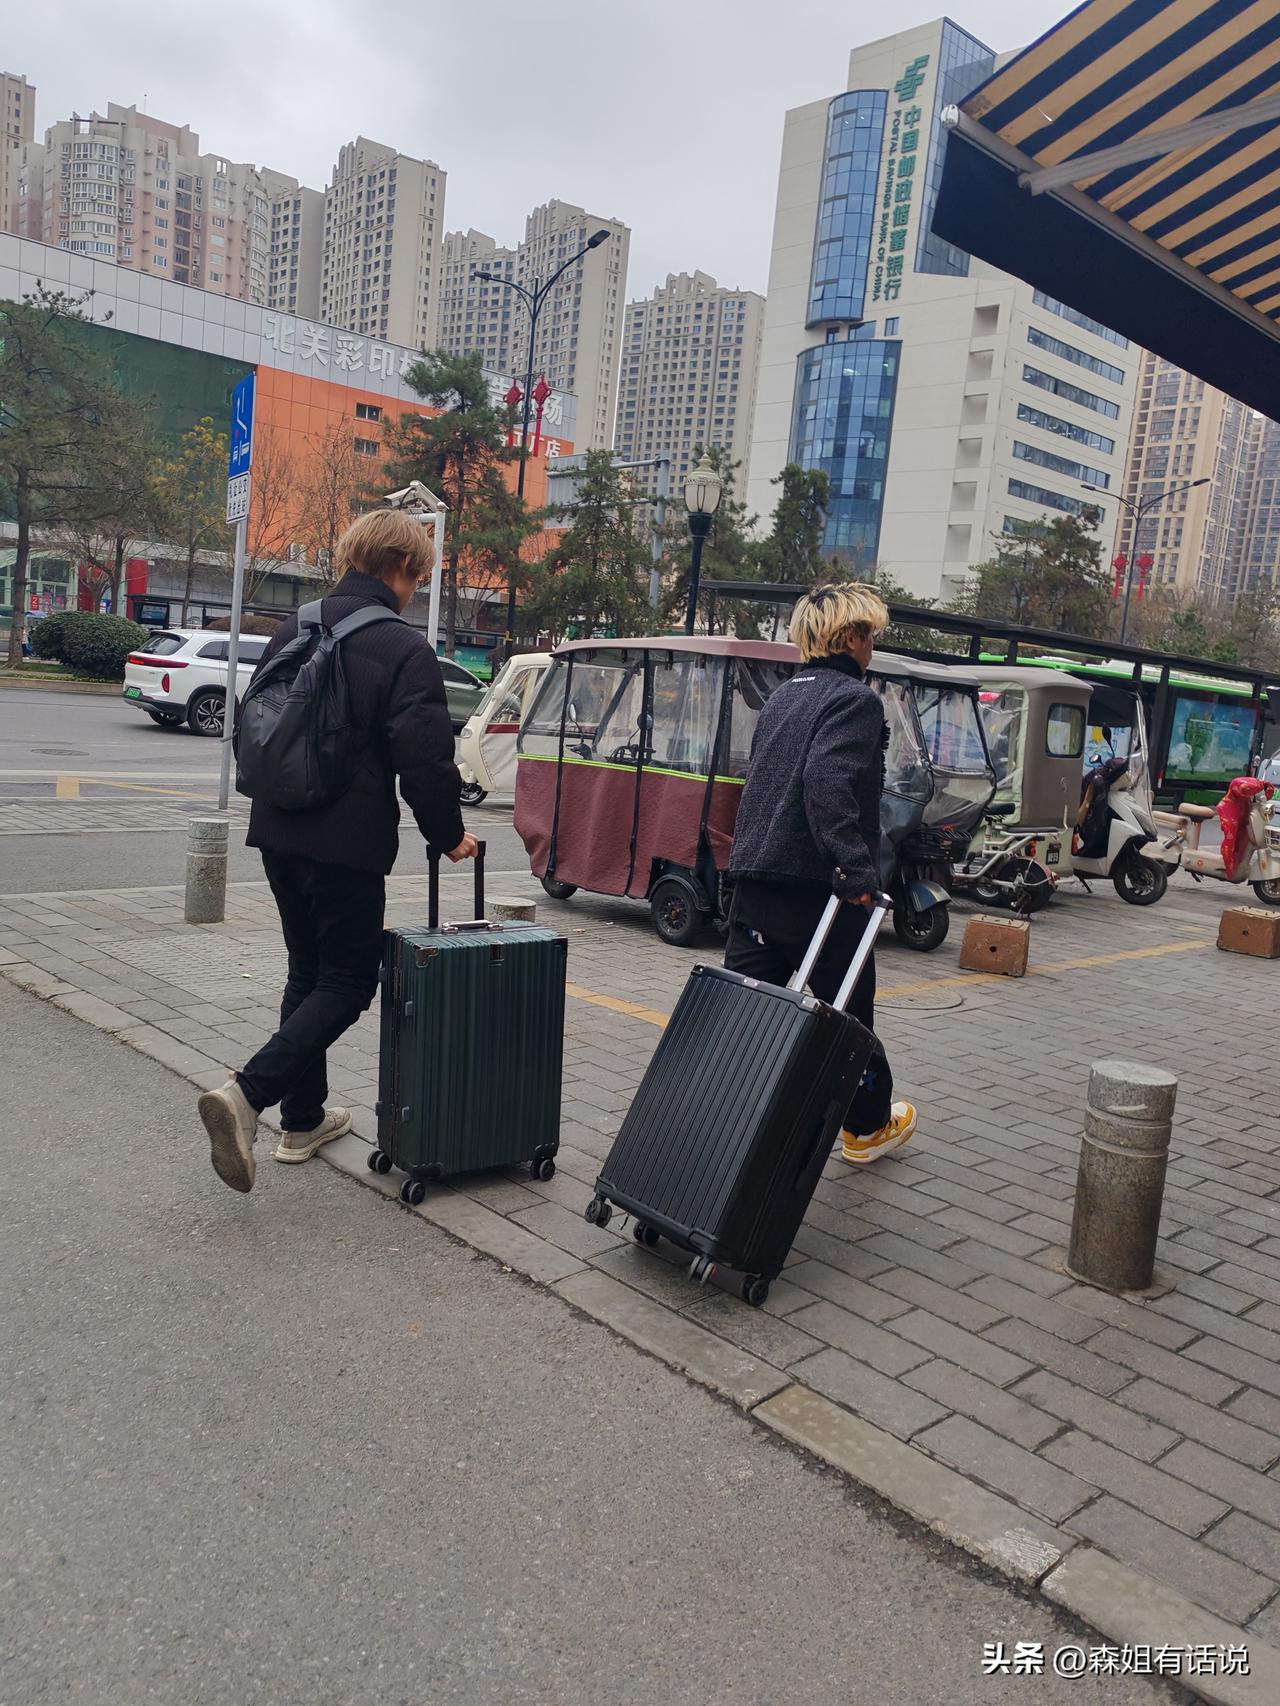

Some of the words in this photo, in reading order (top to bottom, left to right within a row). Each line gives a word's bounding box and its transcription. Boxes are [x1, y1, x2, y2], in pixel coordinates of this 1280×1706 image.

[889, 110, 901, 156] POSTAL
[883, 159, 895, 209] SAVINGS
[884, 105, 921, 300] 中国邮政储蓄银行
[879, 212, 889, 244] BANK
[877, 247, 885, 262] OF
[872, 266, 883, 301] CHINA
